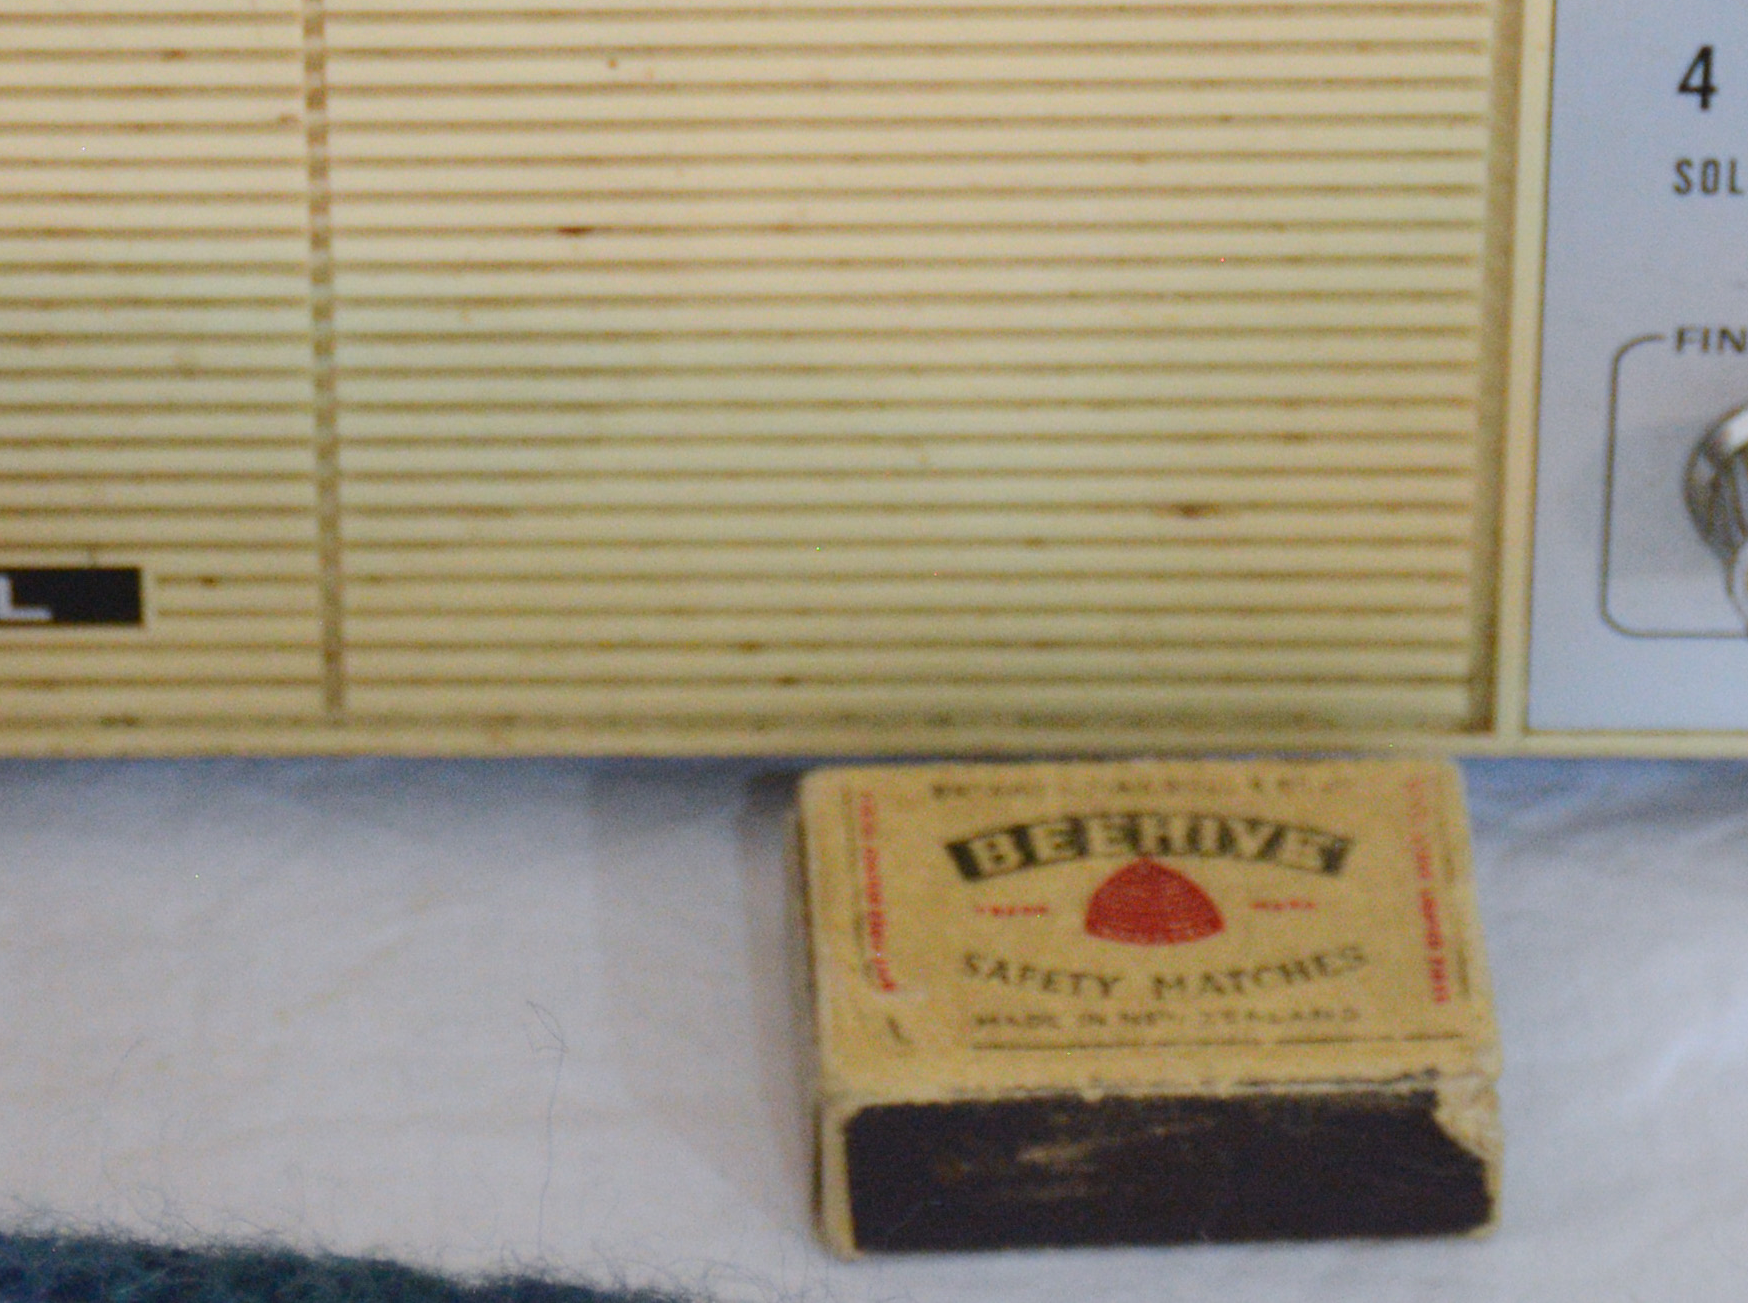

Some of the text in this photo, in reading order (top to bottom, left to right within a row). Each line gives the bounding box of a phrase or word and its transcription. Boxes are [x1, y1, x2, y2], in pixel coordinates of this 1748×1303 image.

[1677, 45, 1717, 111] 4
[971, 812, 1332, 878] BEEHIVE
[960, 944, 1371, 1002] SAFETY MATCHES
